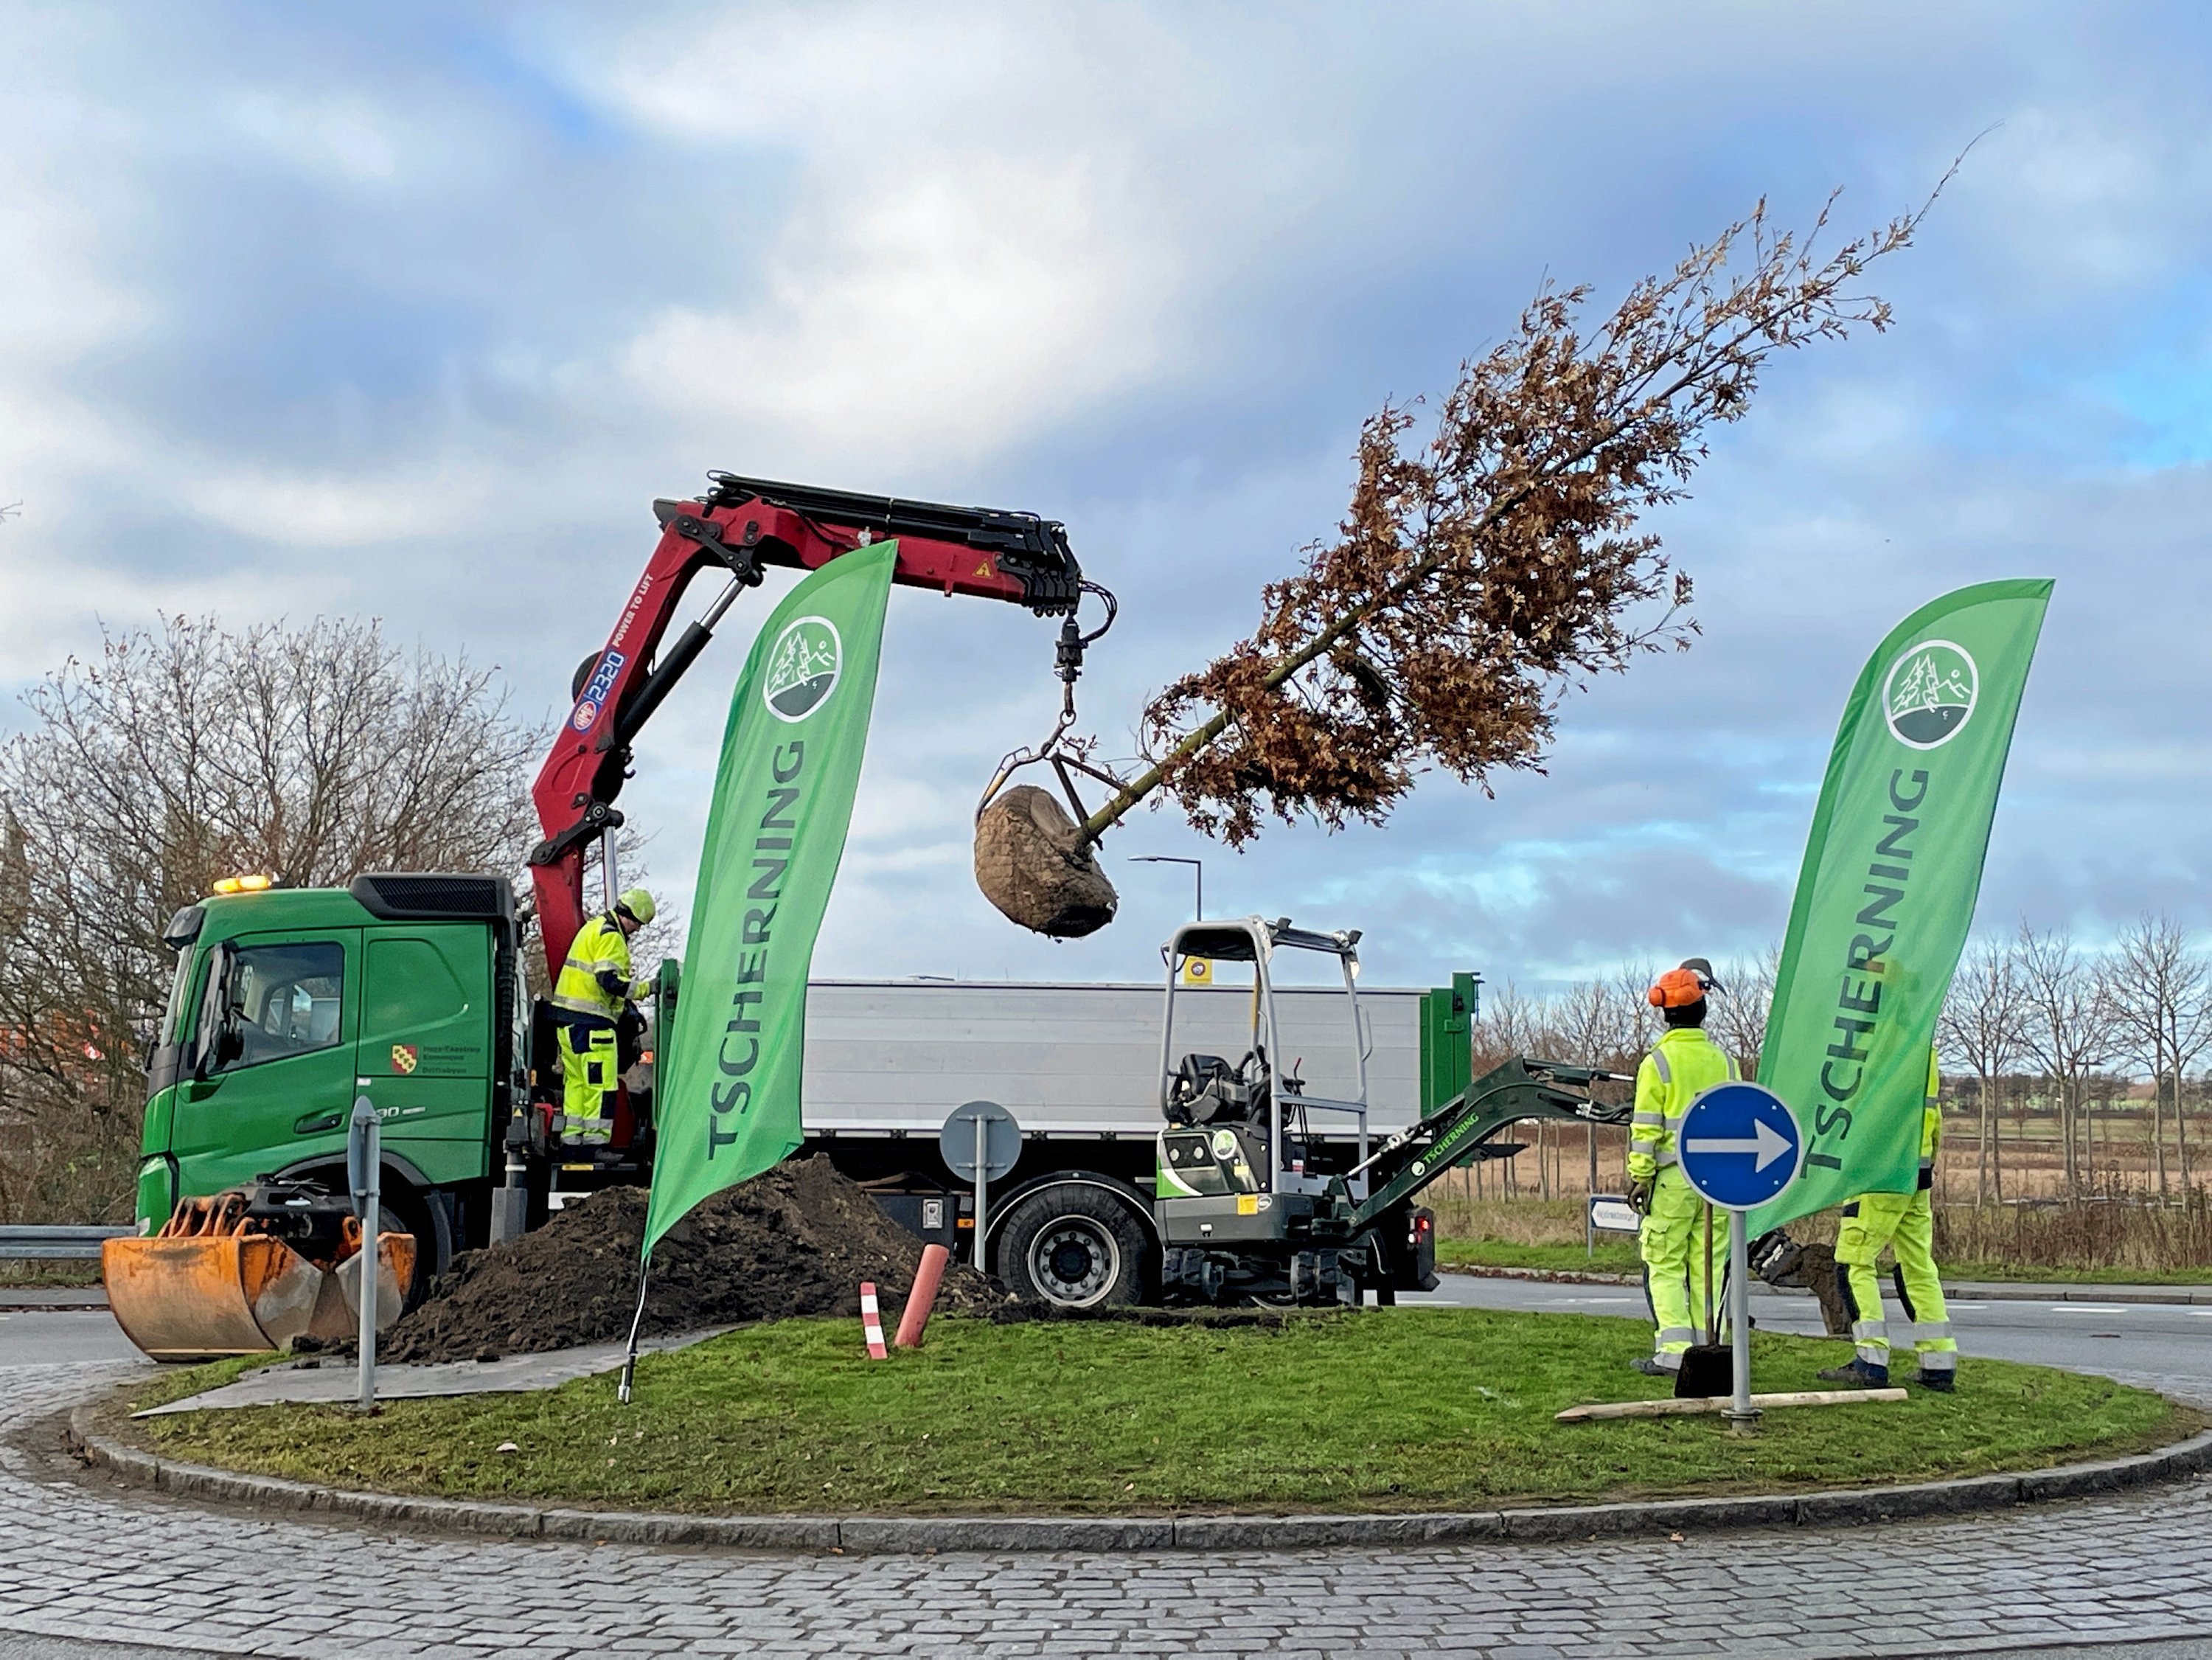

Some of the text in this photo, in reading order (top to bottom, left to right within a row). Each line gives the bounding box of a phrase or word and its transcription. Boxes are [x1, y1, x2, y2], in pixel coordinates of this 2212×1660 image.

[612, 573, 653, 647] POWER TO LIFT
[588, 651, 625, 701] 2320
[577, 704, 594, 726] HMF
[708, 740, 804, 1160] TSCHERNING
[1799, 768, 1929, 1179] TSCHERNING
[1422, 1112, 1479, 1164] TSCHERNING
